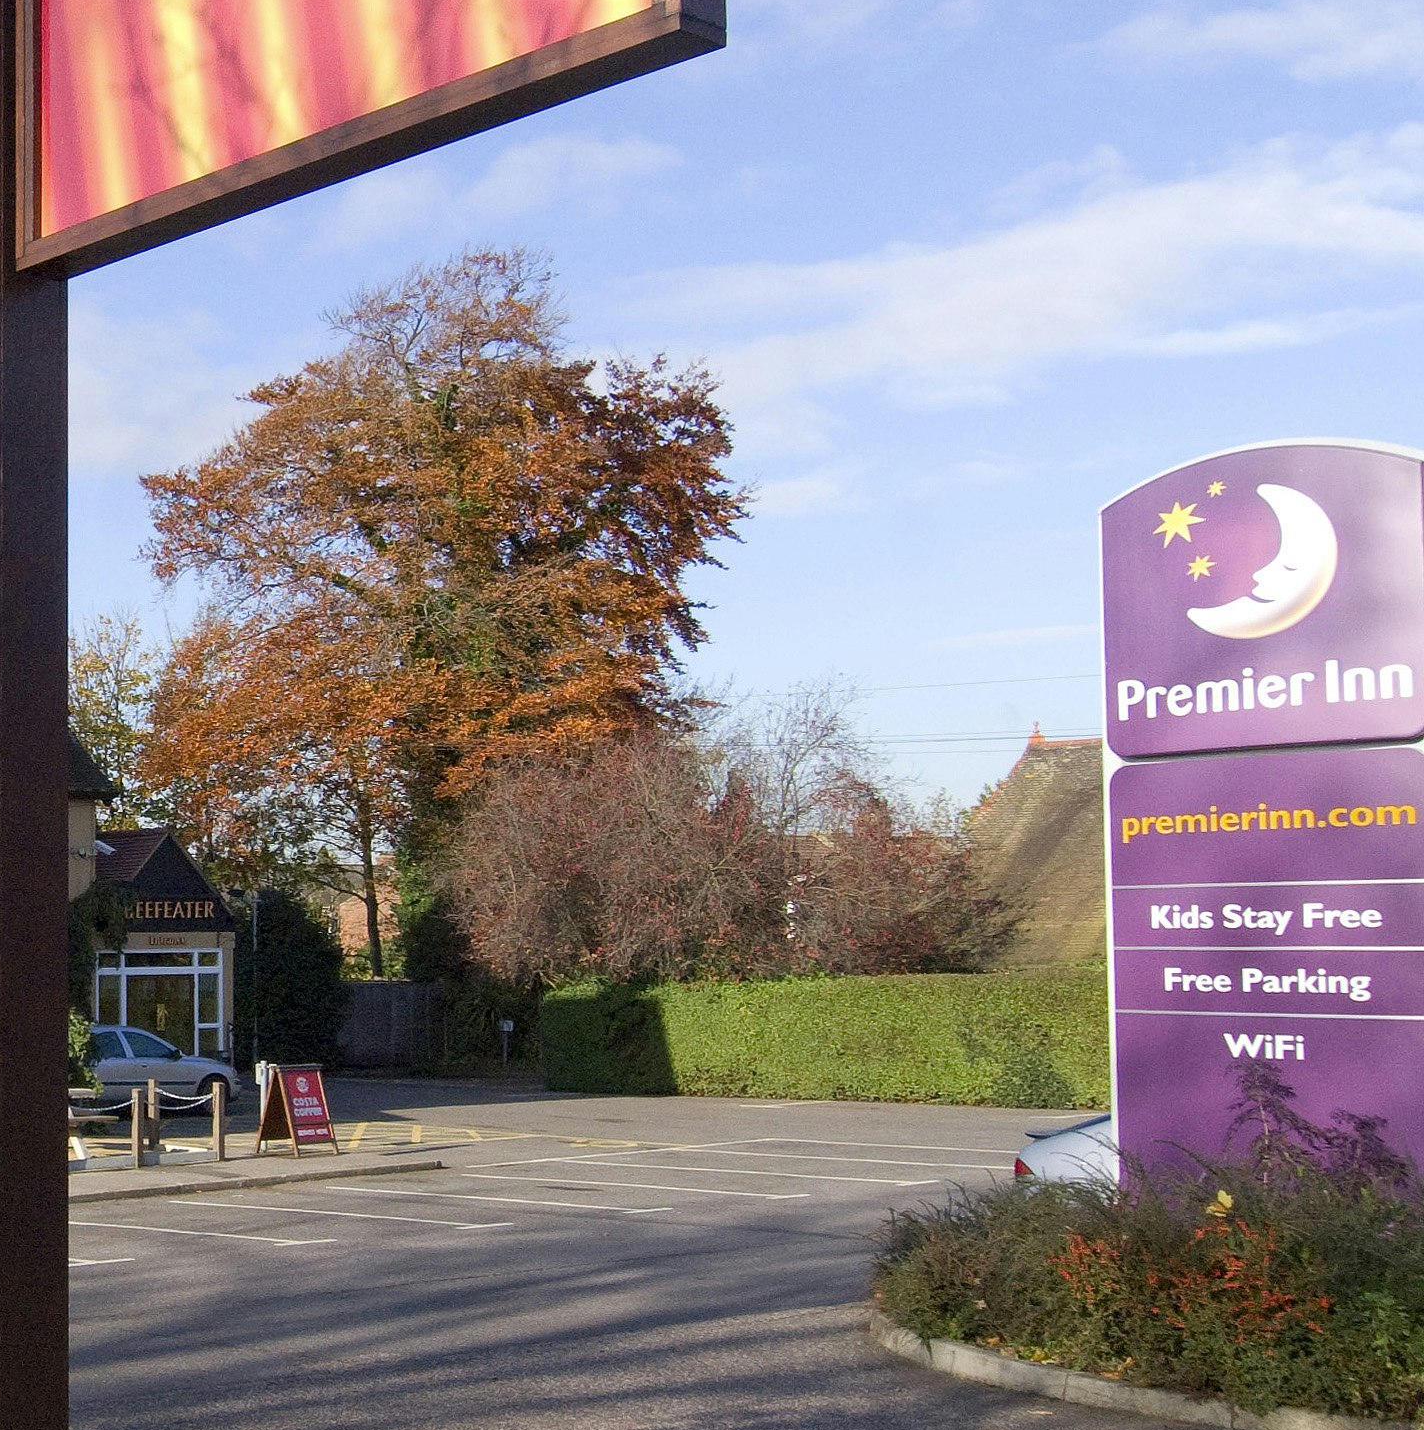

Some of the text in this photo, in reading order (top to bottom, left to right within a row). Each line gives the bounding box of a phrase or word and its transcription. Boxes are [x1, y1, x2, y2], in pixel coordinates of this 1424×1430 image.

[1117, 659, 1414, 722] Premier Inn
[1122, 802, 1418, 843] premierinn.com
[1150, 902, 1383, 936] Kids Stay Free
[1164, 967, 1371, 1002] Free Parking
[1223, 1033, 1305, 1060] WiFi
[293, 1096, 319, 1106] COSTA
